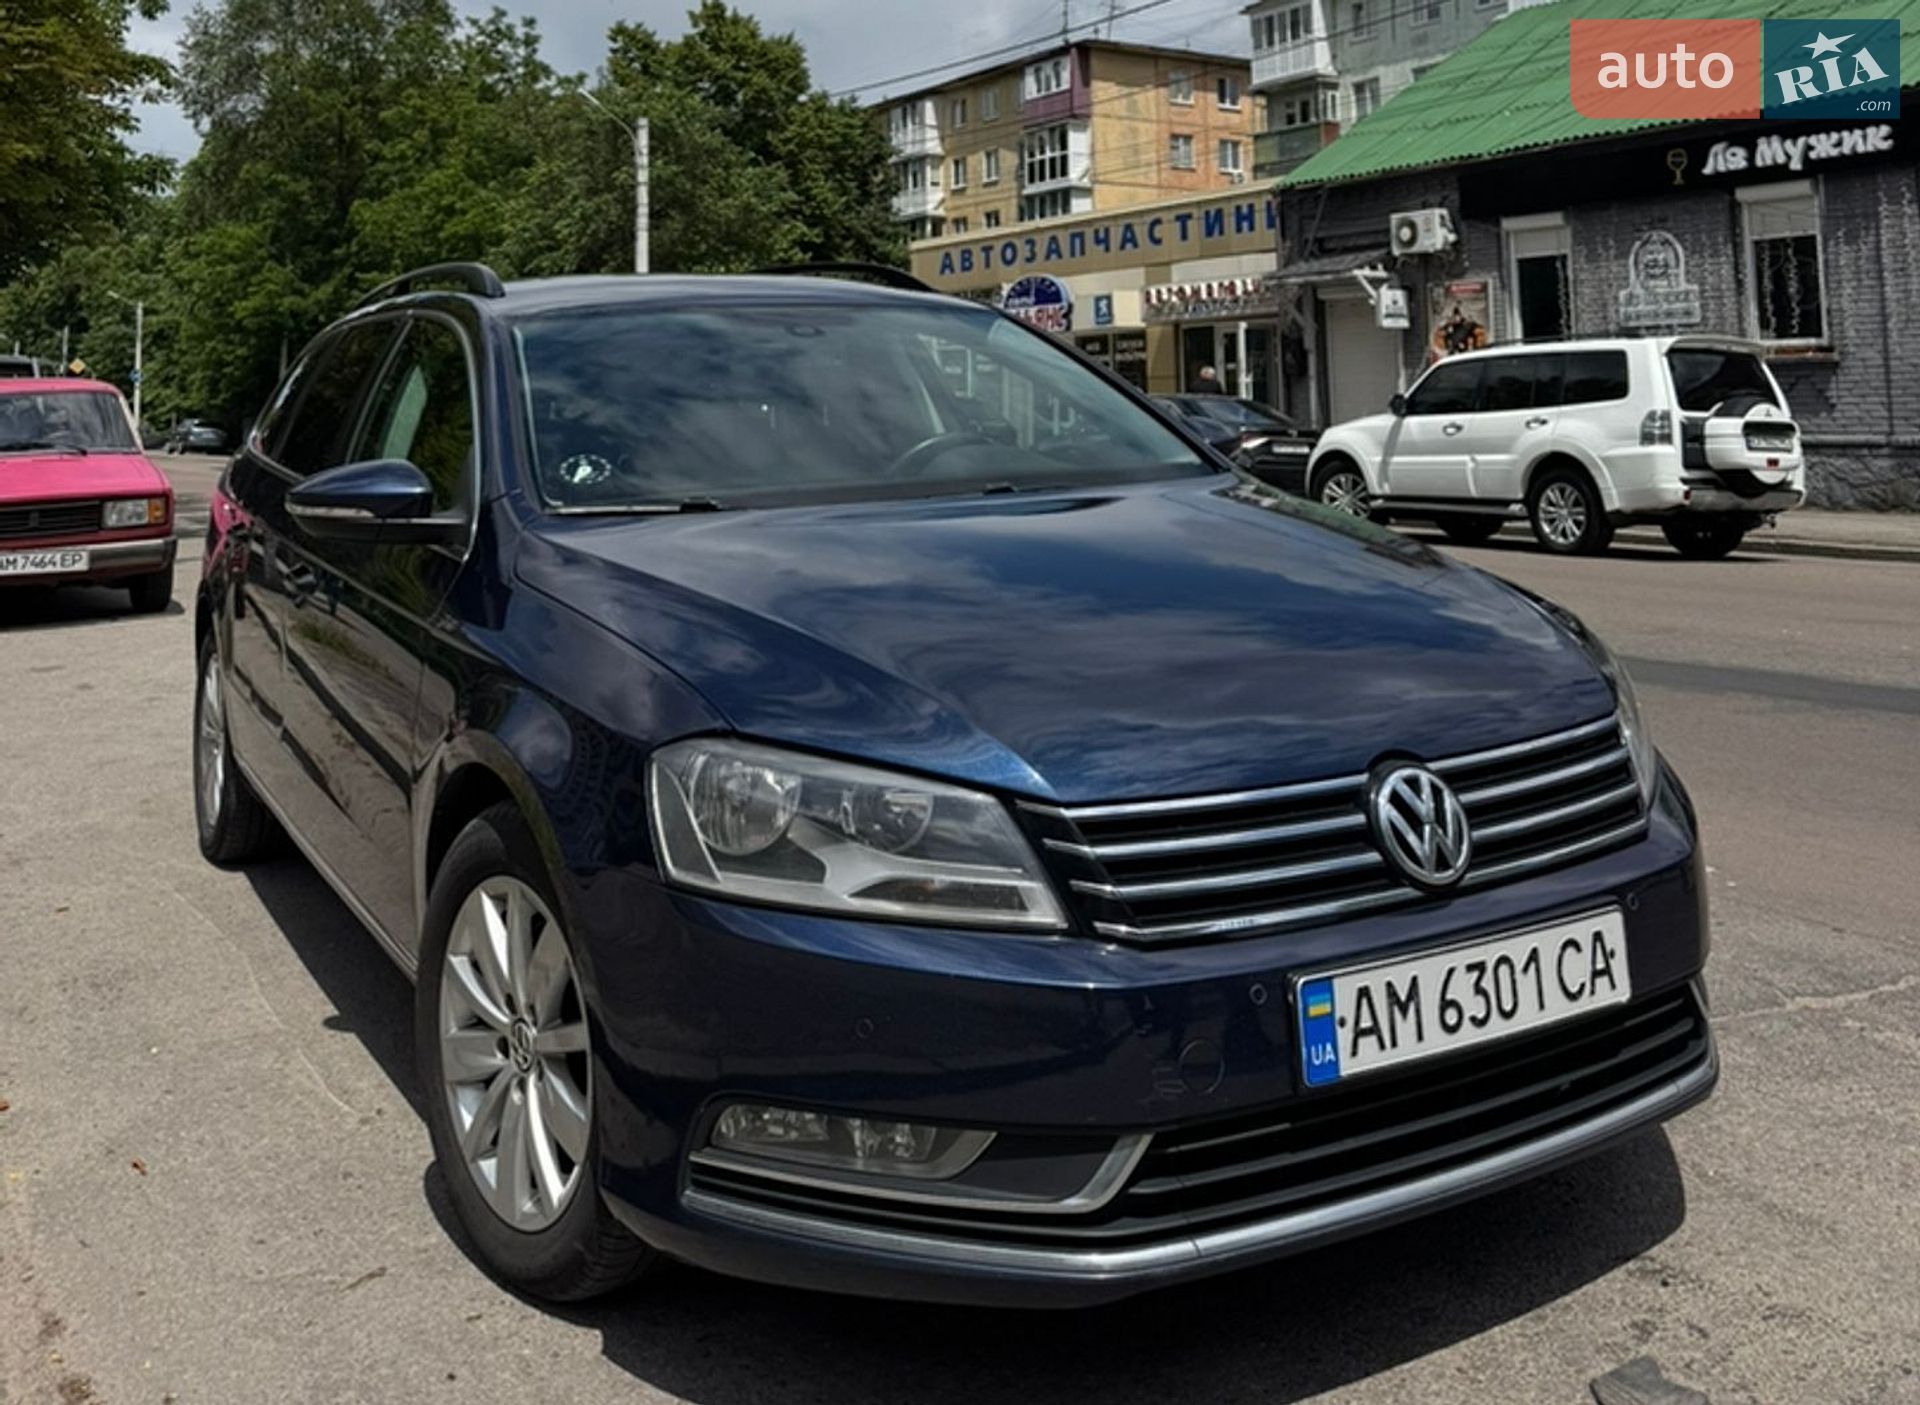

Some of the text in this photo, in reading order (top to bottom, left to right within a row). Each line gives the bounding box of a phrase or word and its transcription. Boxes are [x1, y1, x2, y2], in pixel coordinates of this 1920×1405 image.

[60, 552, 82, 568] EP
[1350, 929, 1617, 1058] AM 6301 CA
[1310, 1043, 1336, 1066] UA
